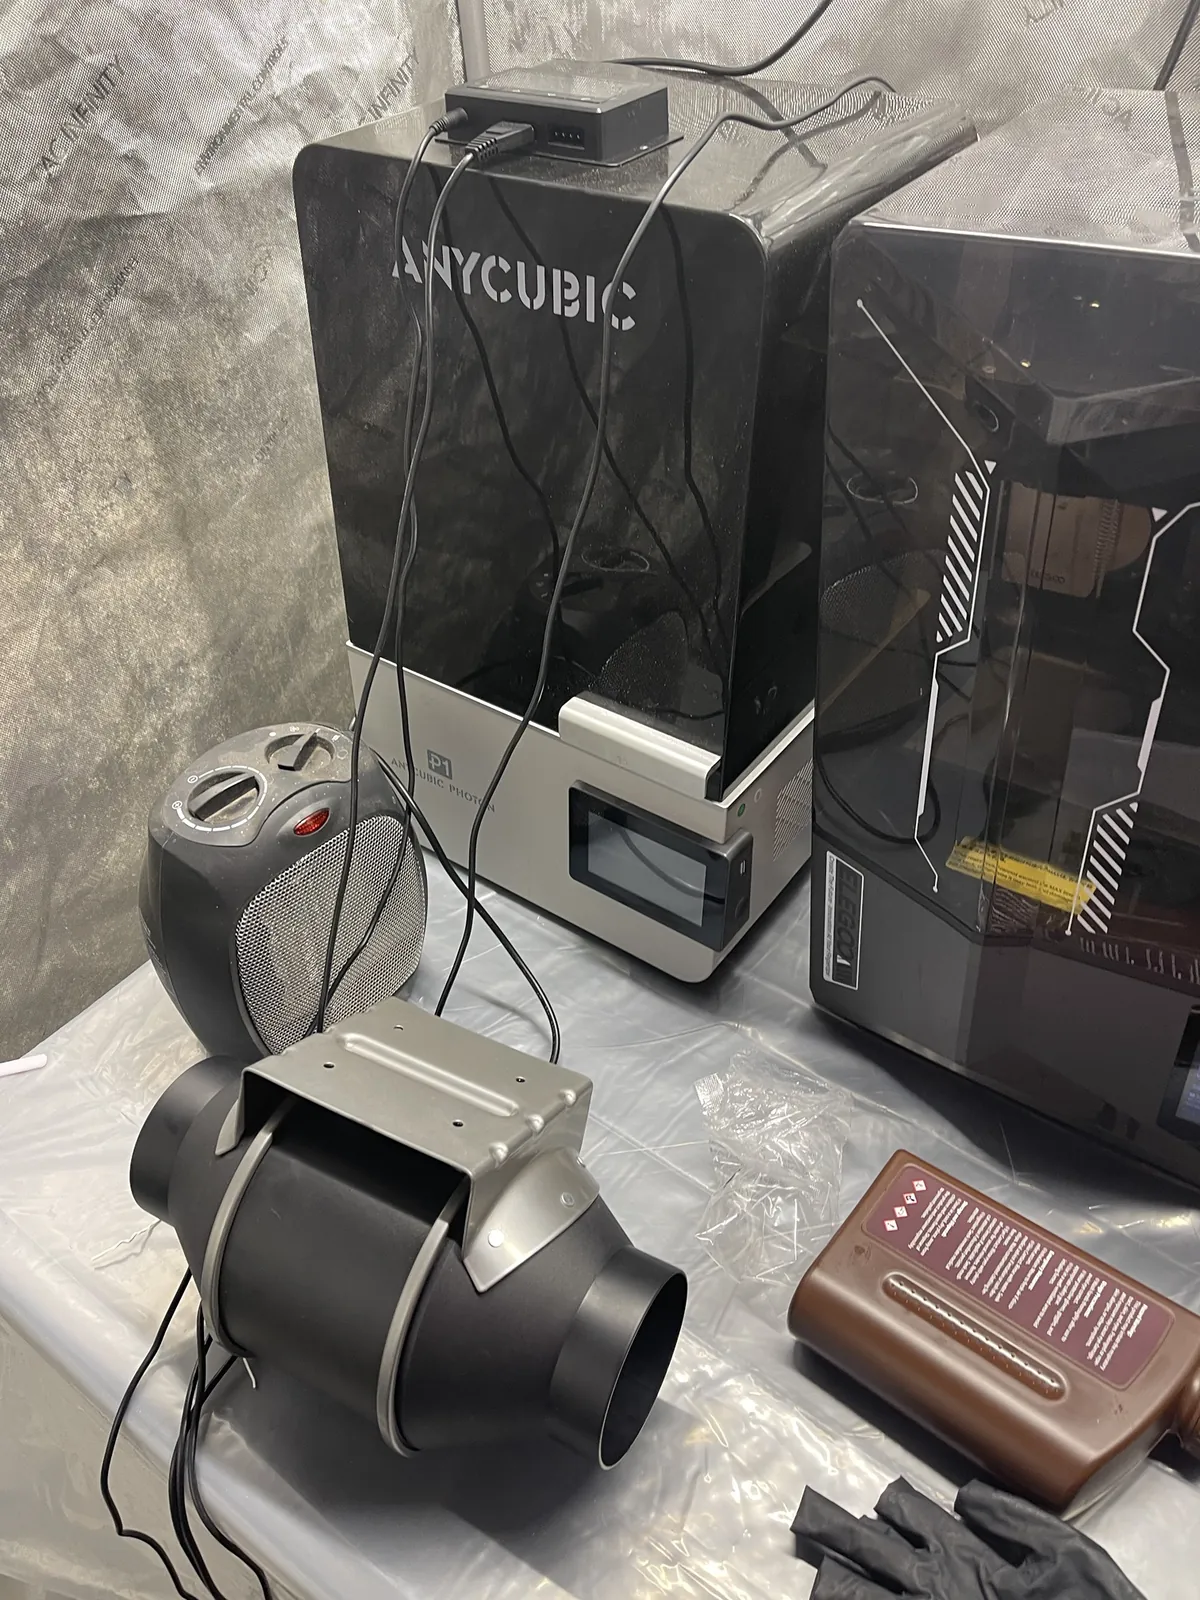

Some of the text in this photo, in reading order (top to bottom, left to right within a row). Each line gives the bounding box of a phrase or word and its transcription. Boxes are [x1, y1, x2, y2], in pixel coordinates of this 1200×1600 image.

[64, 54, 127, 142] INFINITY
[369, 50, 420, 121] INFINITY
[194, 91, 254, 177] ENVIRONMENTAL
[391, 235, 637, 331] ANYCUBIC
[428, 752, 451, 778] P1
[836, 866, 858, 960] ELEGOO
